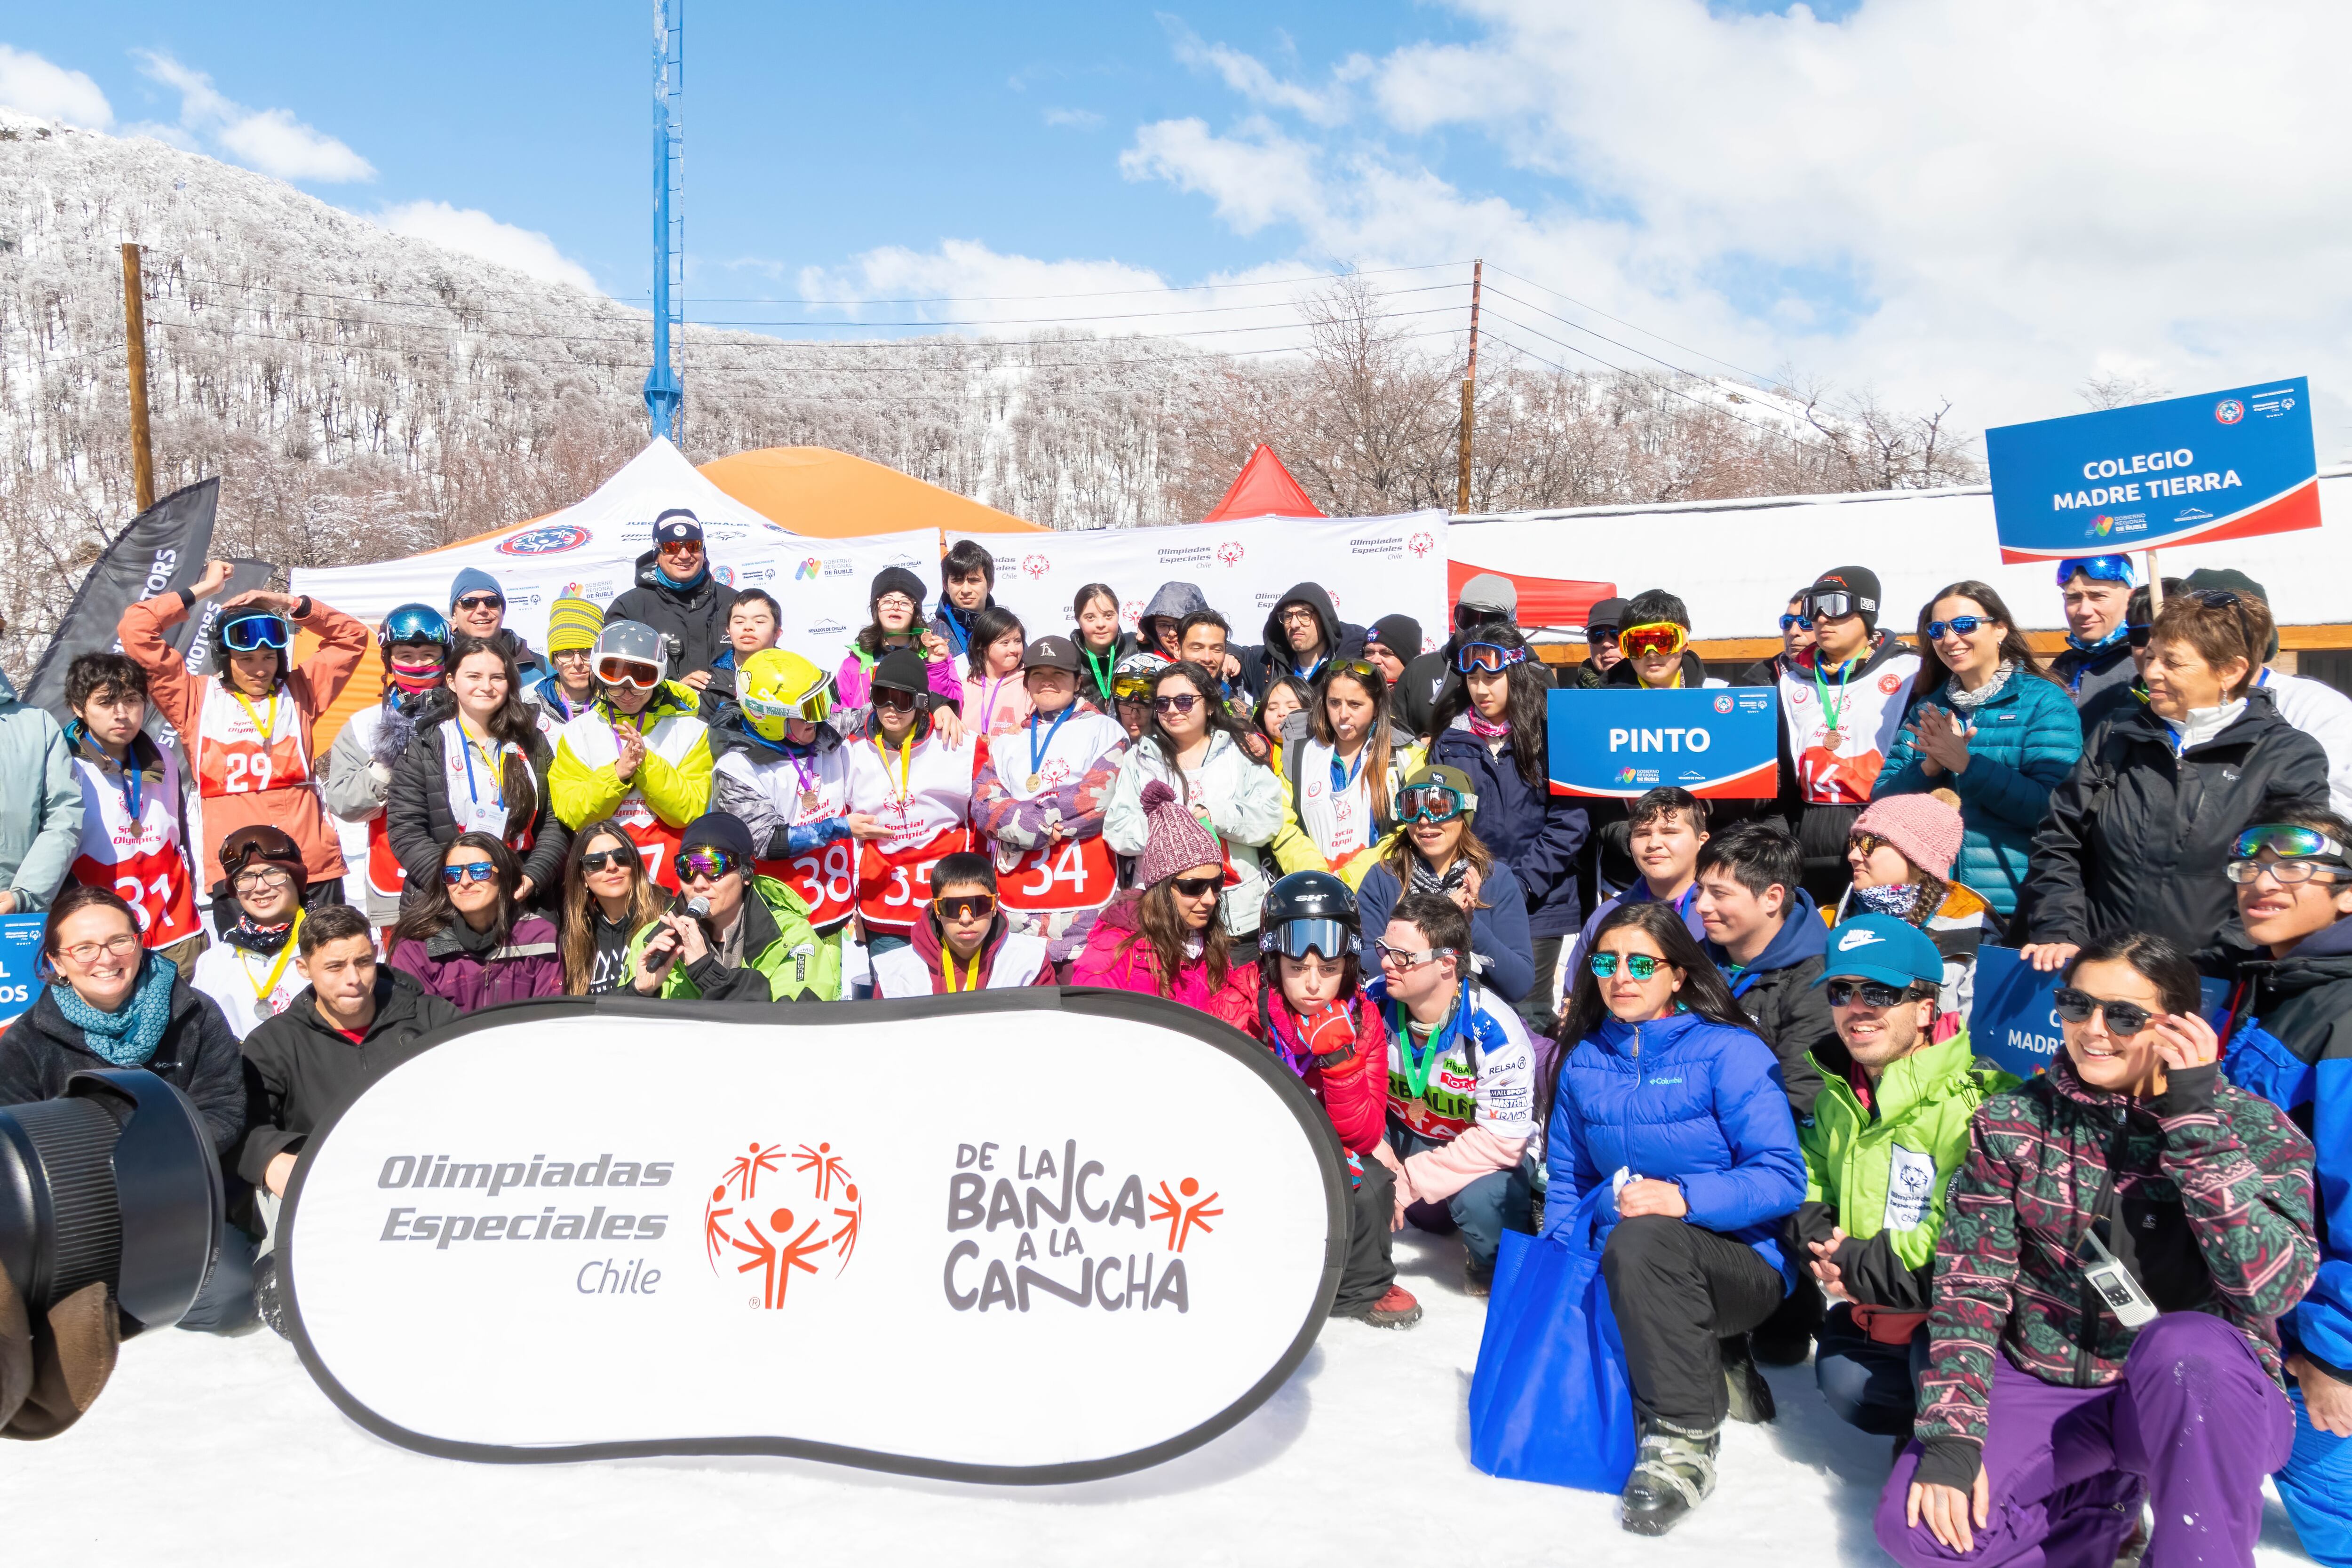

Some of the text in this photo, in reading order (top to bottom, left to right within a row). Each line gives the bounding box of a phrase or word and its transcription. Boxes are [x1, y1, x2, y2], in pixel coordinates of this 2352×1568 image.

[2084, 448, 2193, 479] COLEGIO
[2054, 470, 2242, 511] MADRE TIERRA
[1158, 546, 1211, 556] Olimpiadas
[1160, 554, 1211, 564] Especiales
[1350, 537, 1402, 546] Olimpiadas
[1352, 545, 1402, 555] Especiales
[1610, 728, 1711, 753] PINTO
[226, 753, 272, 793] 29
[1806, 760, 1841, 803] 14
[113, 835, 161, 845] Olympics
[118, 825, 153, 835] Spal
[884, 819, 924, 830] Special
[793, 845, 851, 911] 38
[884, 860, 939, 908] 35
[1023, 840, 1089, 896] 34
[113, 873, 175, 932] 31
[1844, 929, 1875, 942] NIKE
[2008, 1029, 2065, 1055] MADR
[1489, 1062, 1516, 1075] RELSA
[378, 1153, 675, 1197] Olimpiadas
[956, 1142, 1057, 1180] DE LA
[947, 1138, 1146, 1233] BANCA
[379, 1206, 669, 1250] Especiales
[1016, 1226, 1084, 1262] A LA
[576, 1258, 661, 1295] Chile
[944, 1239, 1189, 1313] CANCHA
